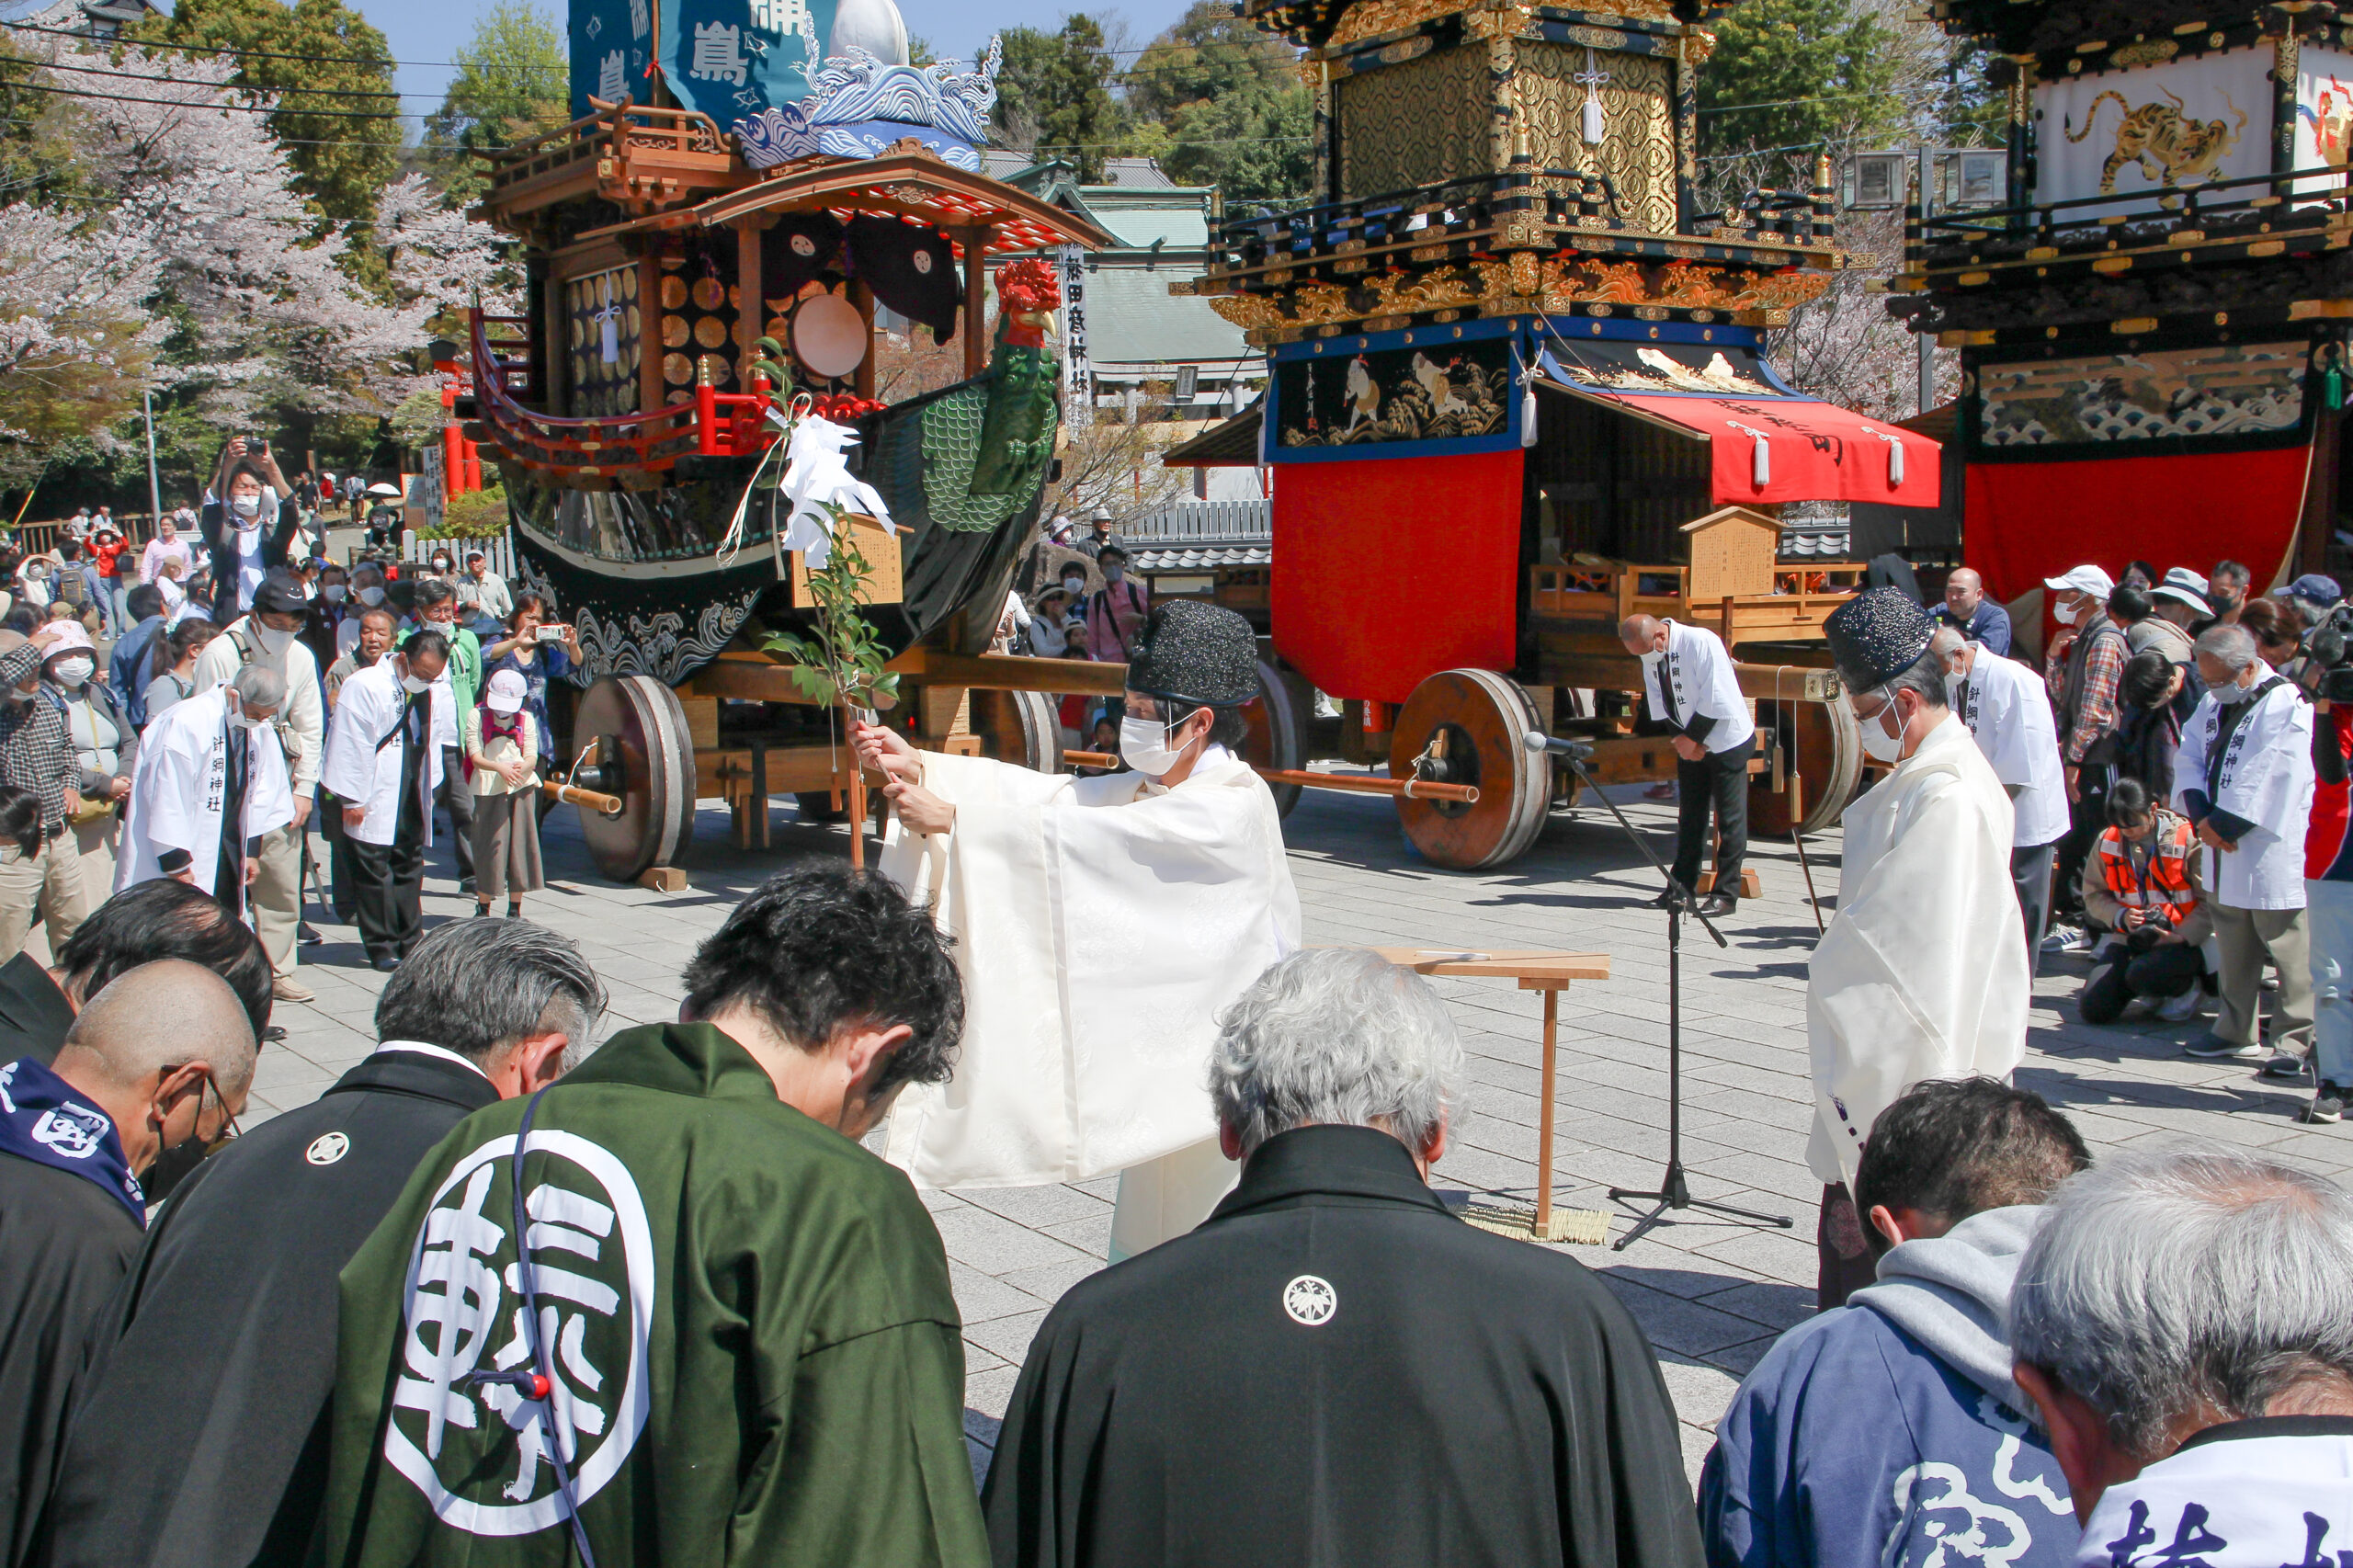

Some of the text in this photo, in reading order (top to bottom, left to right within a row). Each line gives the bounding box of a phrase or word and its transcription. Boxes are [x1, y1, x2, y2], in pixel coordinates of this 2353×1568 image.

[206, 735, 224, 812] 針綱神社
[2220, 715, 2254, 789] 針綱神社
